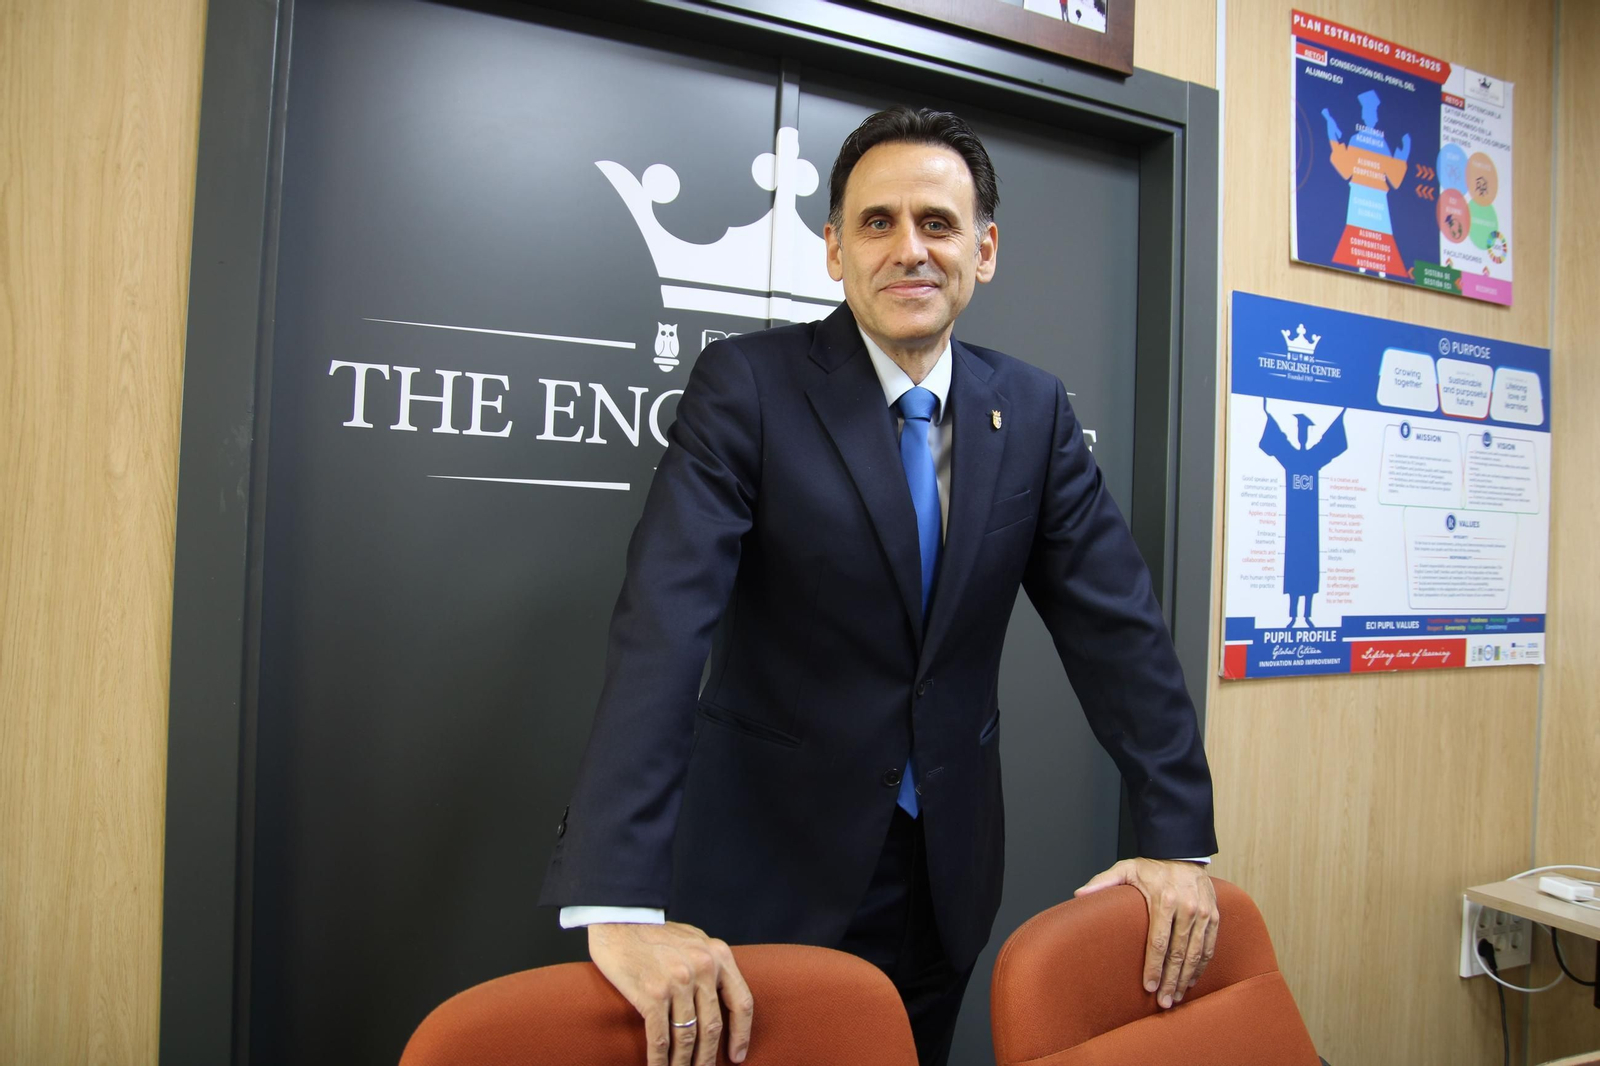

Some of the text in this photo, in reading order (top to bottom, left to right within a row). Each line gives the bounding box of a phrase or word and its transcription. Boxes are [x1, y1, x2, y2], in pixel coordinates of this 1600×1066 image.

[1294, 14, 1442, 72] PLAN ESTRATÉGICO 2021-2025
[1305, 66, 1332, 82] ALUMNO
[1330, 58, 1373, 78] CONSECUCIÓN
[1374, 73, 1384, 82] DEL
[1385, 75, 1404, 88] PERFIL
[1404, 80, 1416, 92] DEL
[1358, 157, 1380, 170] ALUMNOS
[1359, 229, 1382, 241] ALUMNOS
[1351, 247, 1386, 262] EQUILIBRADOS
[1444, 248, 1482, 264] FACILITADORES
[1452, 341, 1491, 359] PURPOSE
[1258, 357, 1341, 378] THE ENGLISH CENTRE
[1394, 367, 1421, 380] Growing
[1394, 378, 1422, 389] together
[1448, 377, 1482, 388] Sustainable
[329, 360, 513, 437] THE
[1456, 388, 1488, 399] purposeful
[1456, 398, 1474, 406] future
[1505, 402, 1528, 413] learning
[1416, 433, 1442, 443] MISSION
[1293, 474, 1313, 490] ECI
[1366, 621, 1420, 630] ECI PUPIL VALUES
[1264, 630, 1337, 643] PUPIL PROFILE
[1272, 645, 1296, 659] Global
[1362, 647, 1451, 666] Lifelong love of learning
